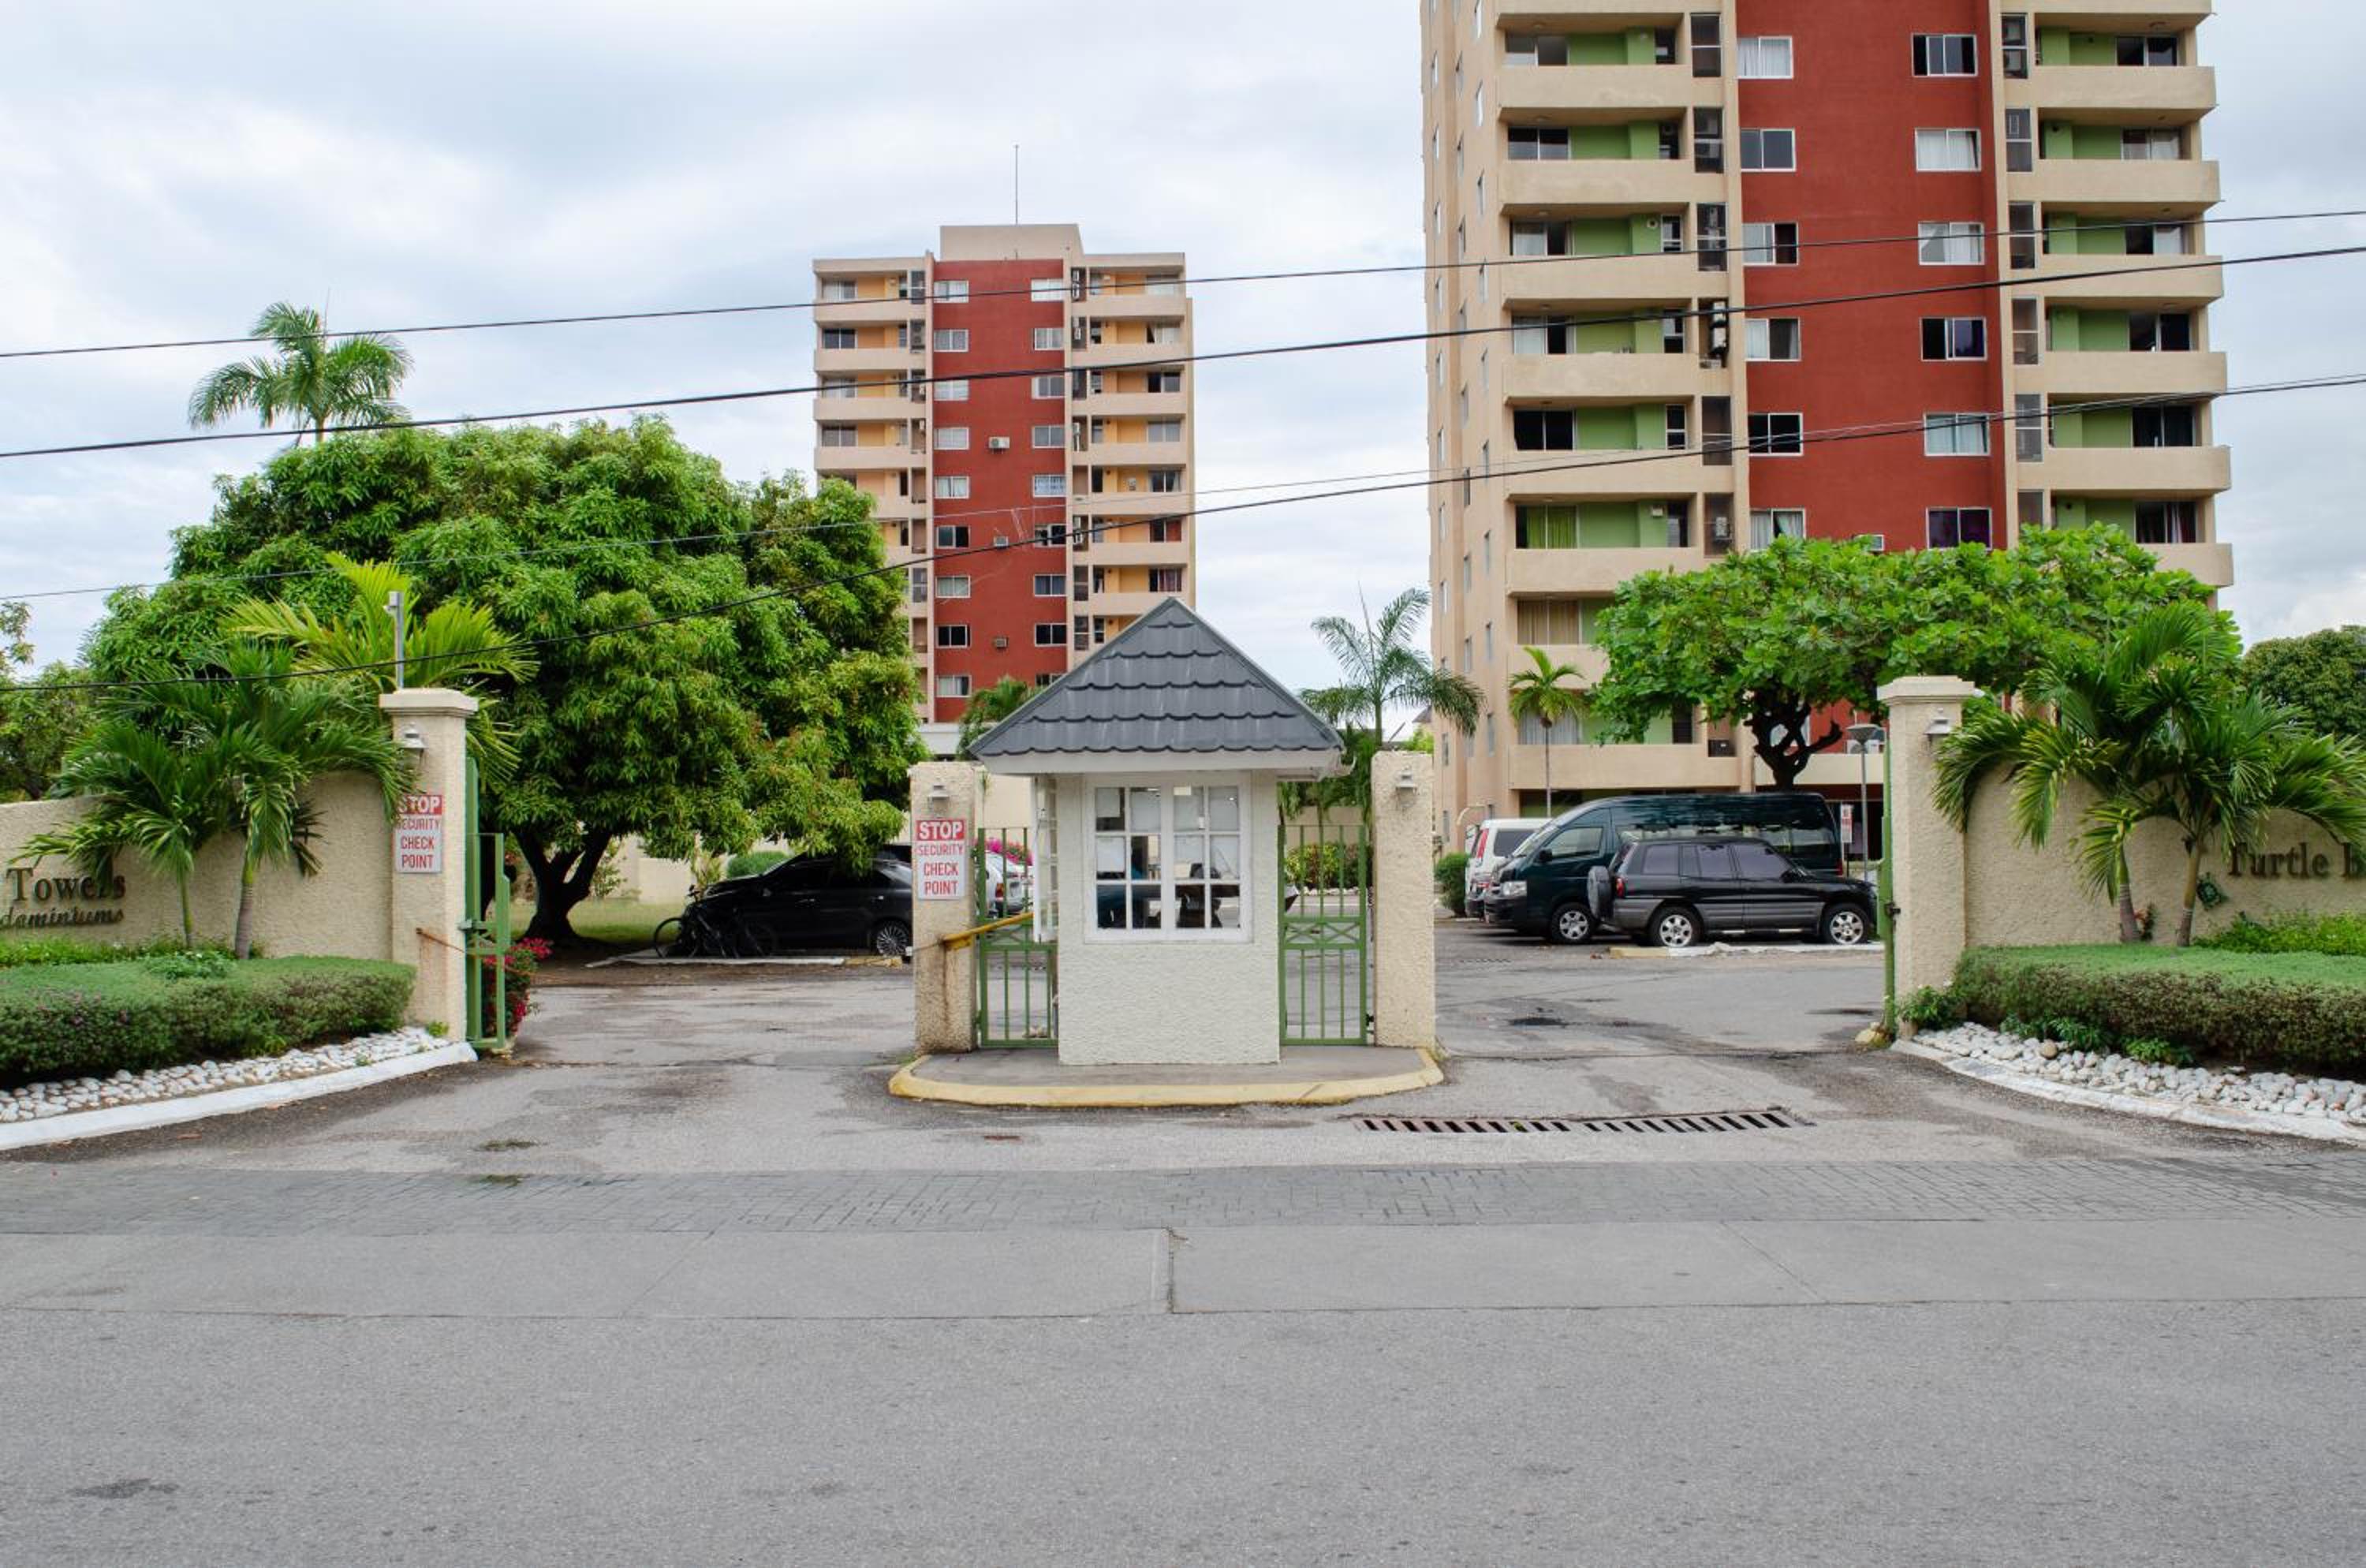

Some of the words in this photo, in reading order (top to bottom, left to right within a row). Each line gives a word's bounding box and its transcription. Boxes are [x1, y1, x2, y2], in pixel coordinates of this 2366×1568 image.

[396, 796, 440, 814] STOP
[919, 821, 963, 839] STOP
[401, 836, 435, 849] CHECK
[918, 845, 964, 856] SECURITY
[401, 854, 435, 868] POINT
[2228, 842, 2330, 878] Turtle
[924, 862, 959, 876] CHECK
[924, 880, 959, 894] POINT
